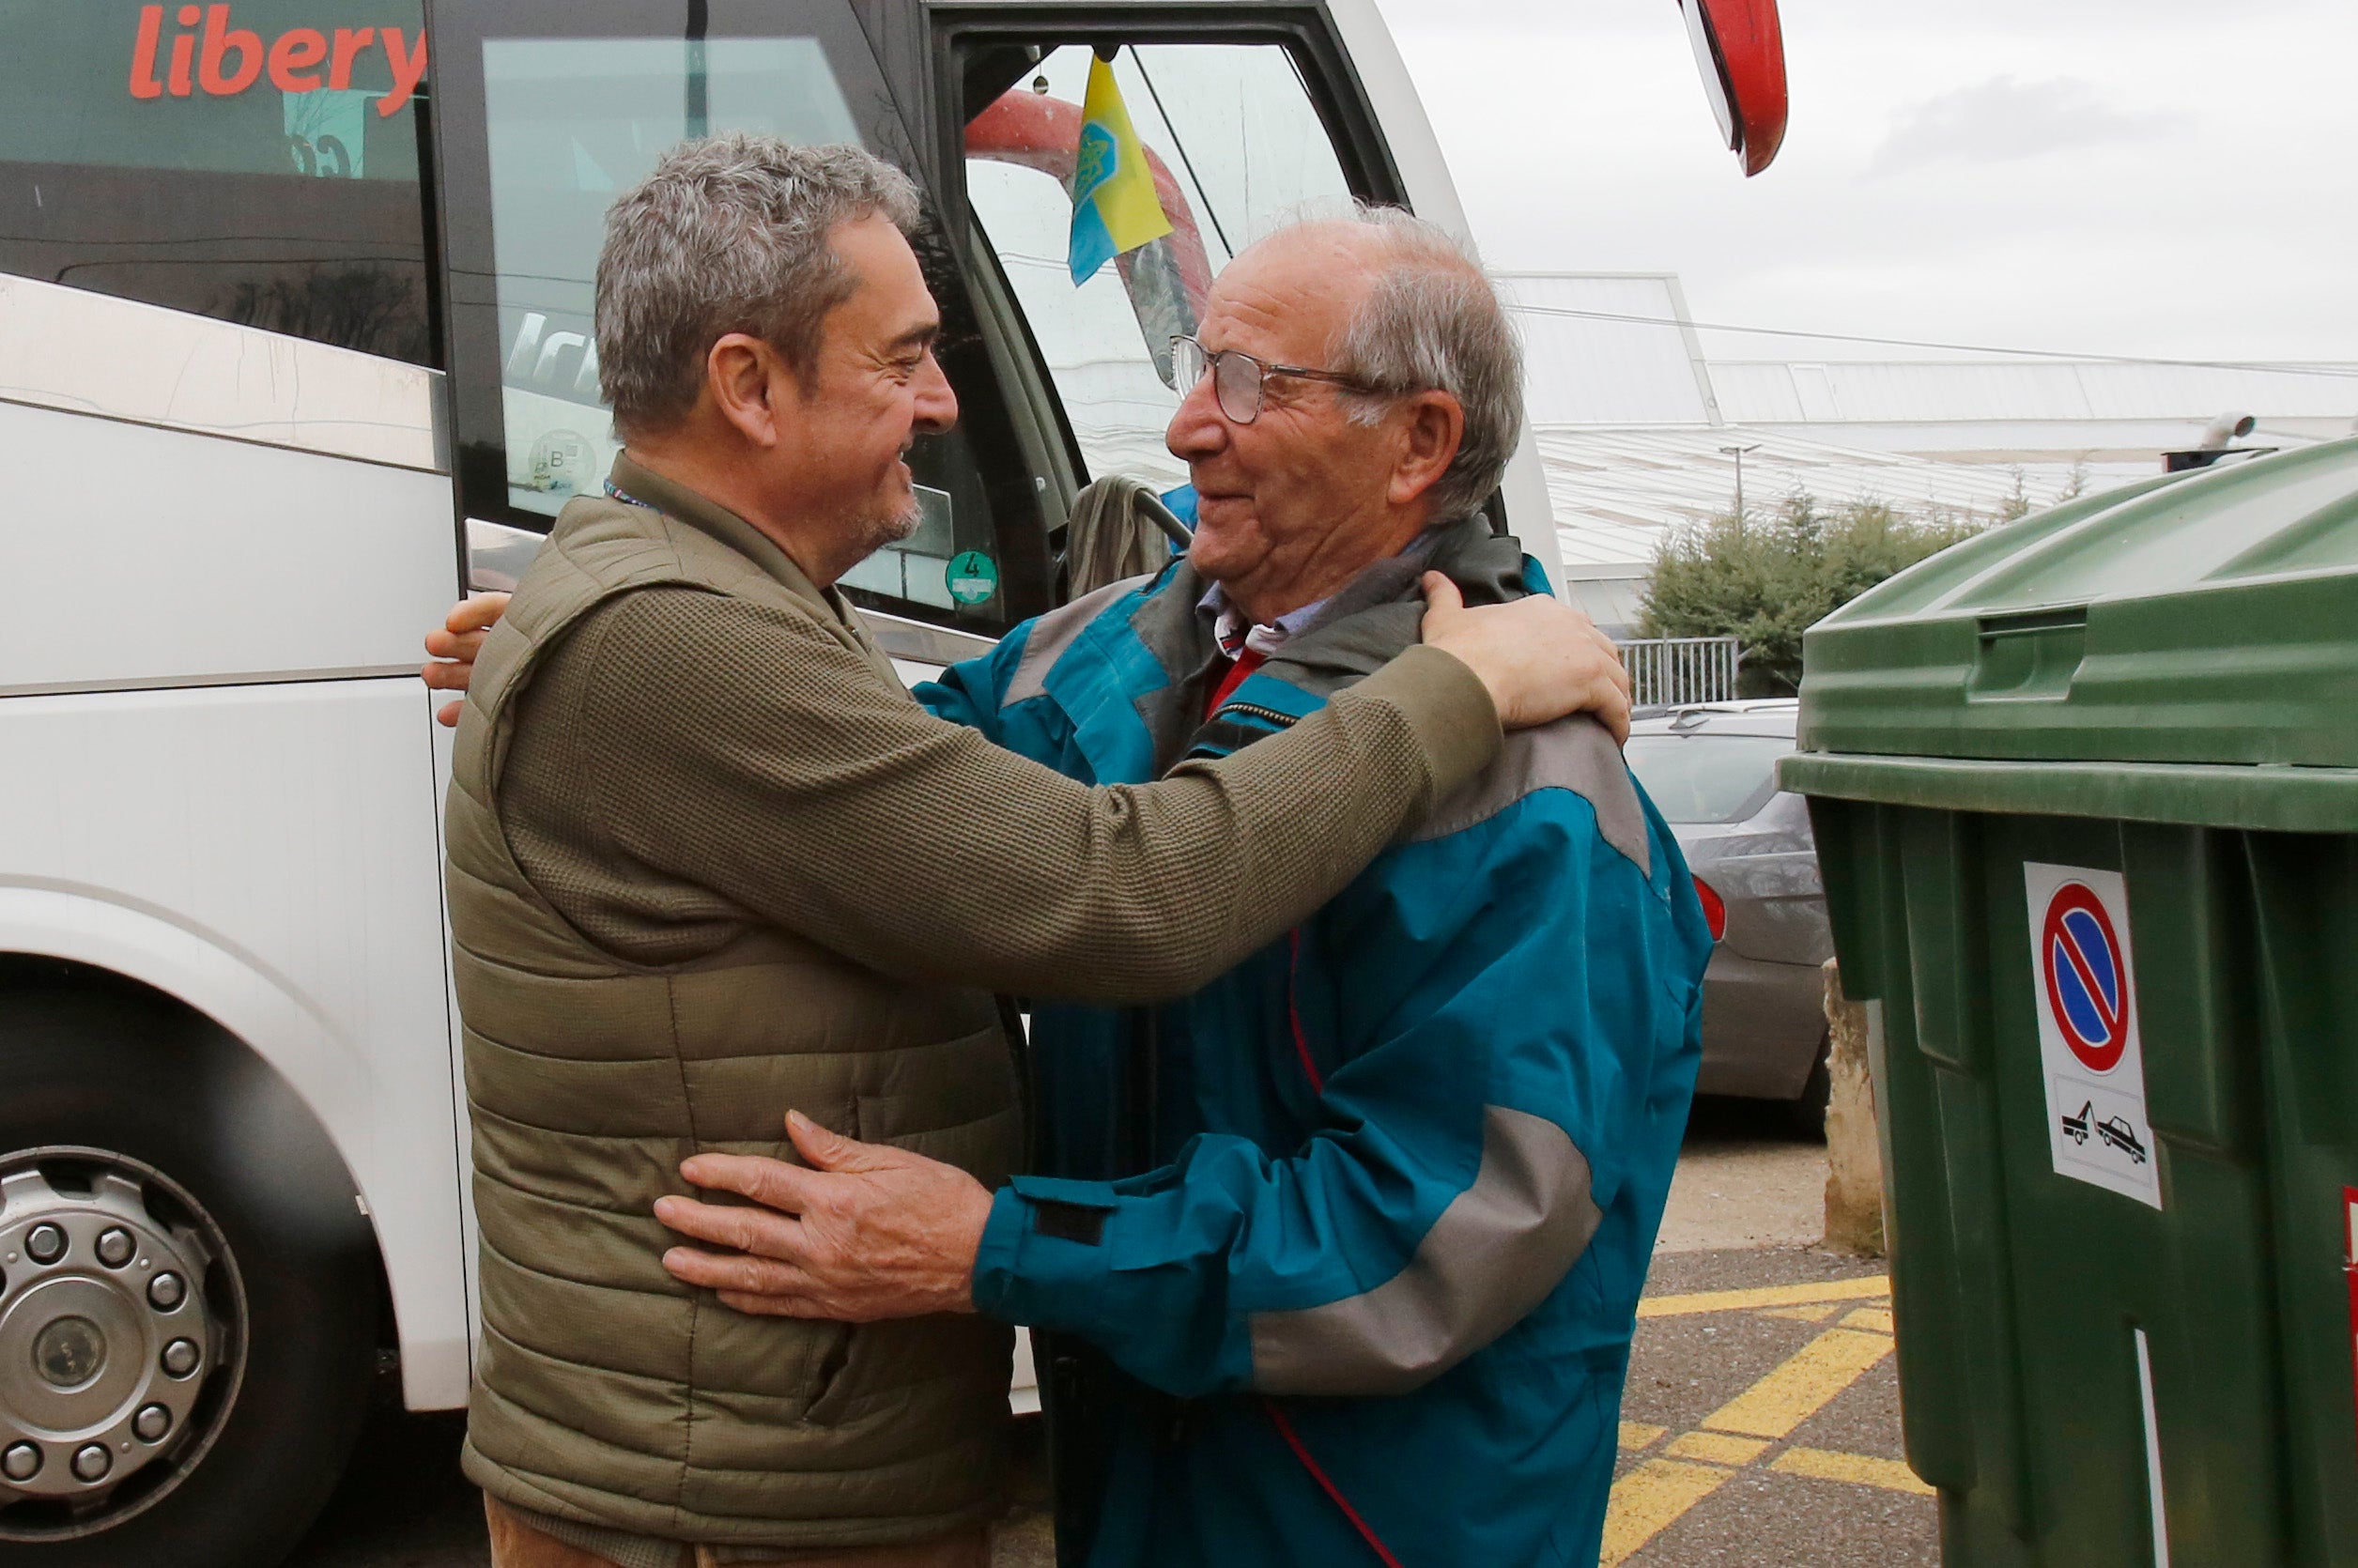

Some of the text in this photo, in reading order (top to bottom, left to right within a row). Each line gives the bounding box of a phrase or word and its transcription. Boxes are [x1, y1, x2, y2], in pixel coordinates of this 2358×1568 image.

[129, 3, 429, 117] libery
[550, 451, 564, 468] B
[964, 552, 980, 578] 4
